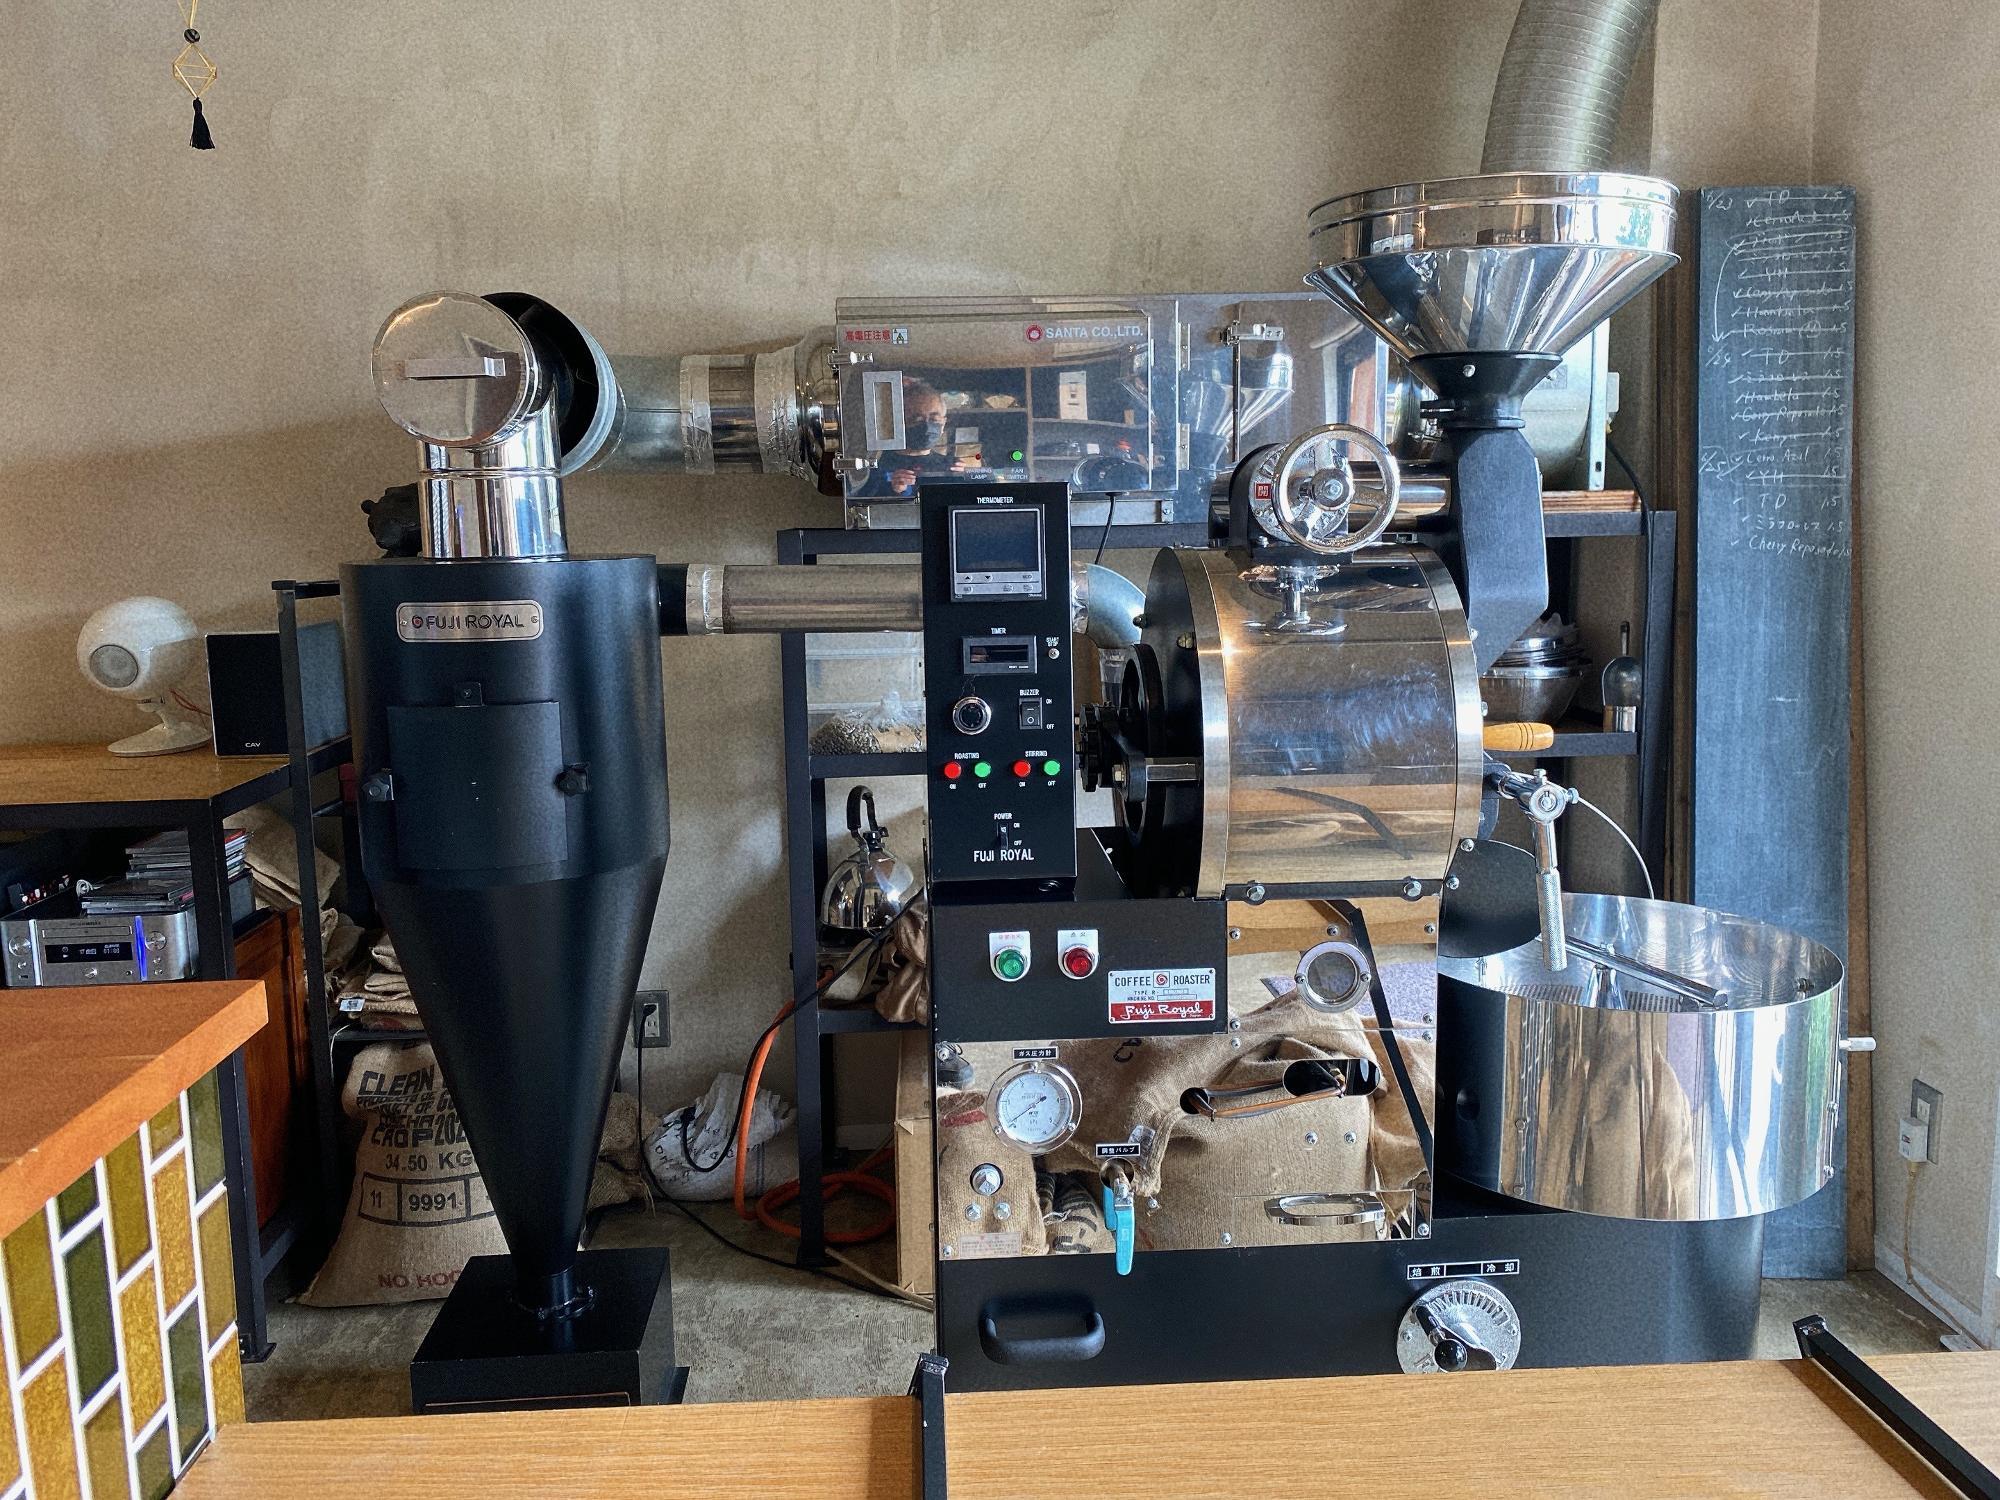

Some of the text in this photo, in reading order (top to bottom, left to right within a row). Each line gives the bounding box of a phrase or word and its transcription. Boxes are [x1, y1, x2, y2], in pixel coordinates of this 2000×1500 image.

[1046, 325, 1144, 339] SANTA CO.,LTD.
[976, 496, 1014, 504] THERMOMETER
[426, 614, 525, 630] FUJI ROYAL
[991, 627, 1007, 635] TIMER
[954, 752, 980, 760] ROASTING
[973, 849, 1035, 862] FUJI ROYAL
[1114, 974, 1211, 987] COFFEE ROASTER
[1120, 1002, 1204, 1019] Fuji Royal
[358, 1064, 435, 1096] CLEAN
[1101, 1146, 1135, 1154] 調整バルブ
[385, 1149, 473, 1172] 34.50 KG
[370, 1189, 383, 1208] 11
[1412, 1262, 1515, 1277] 焙煎 冷却
[378, 1273, 409, 1288] NO
